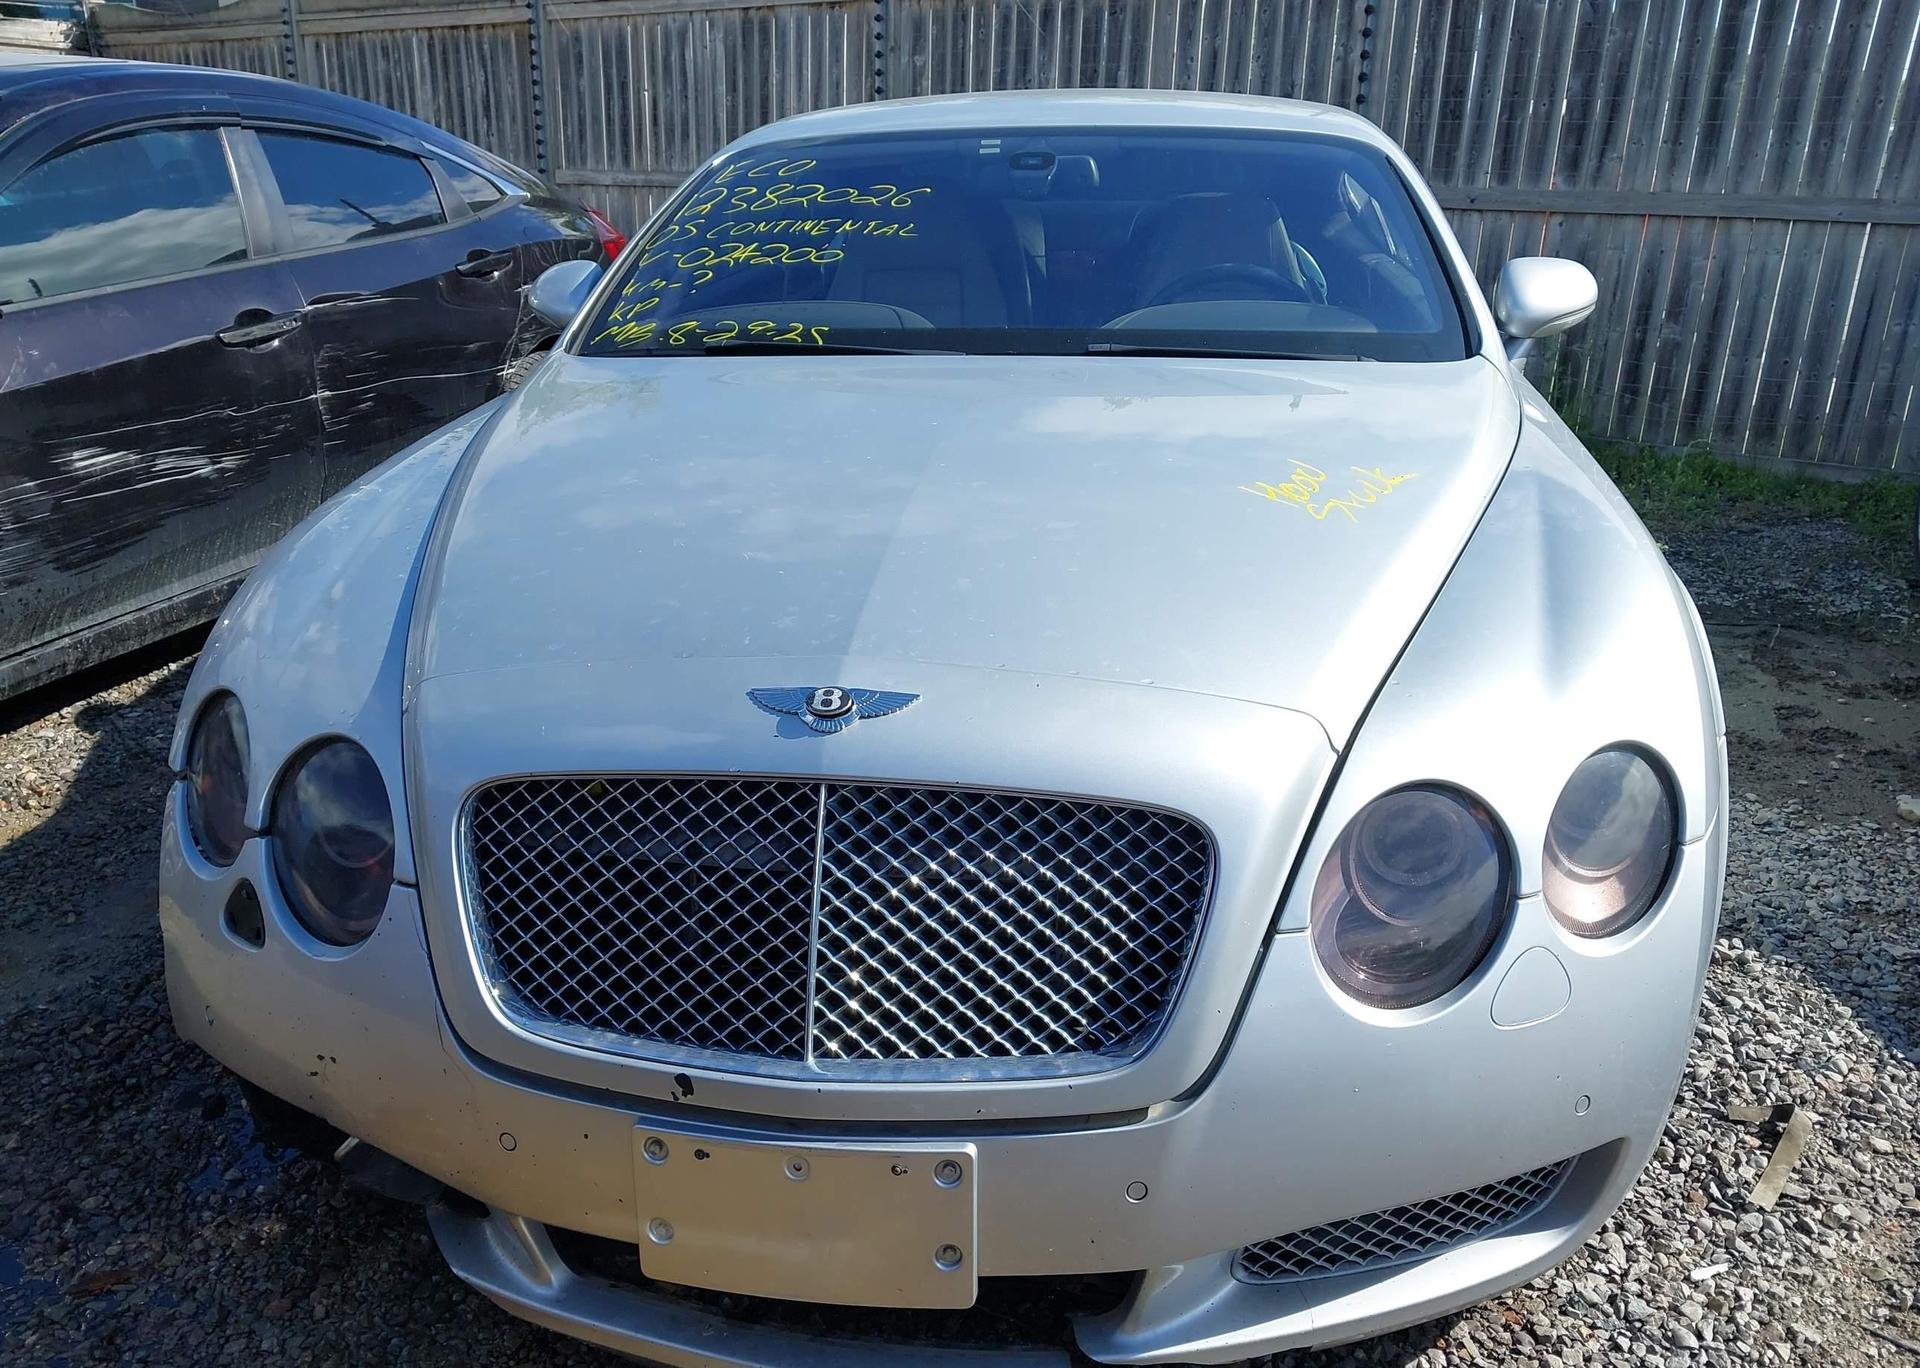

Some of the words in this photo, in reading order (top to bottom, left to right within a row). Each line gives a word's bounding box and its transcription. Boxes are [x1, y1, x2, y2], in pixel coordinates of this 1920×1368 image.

[715, 159, 817, 183] ECO
[706, 219, 919, 239] CONTINENTAL
[811, 686, 844, 711] B
